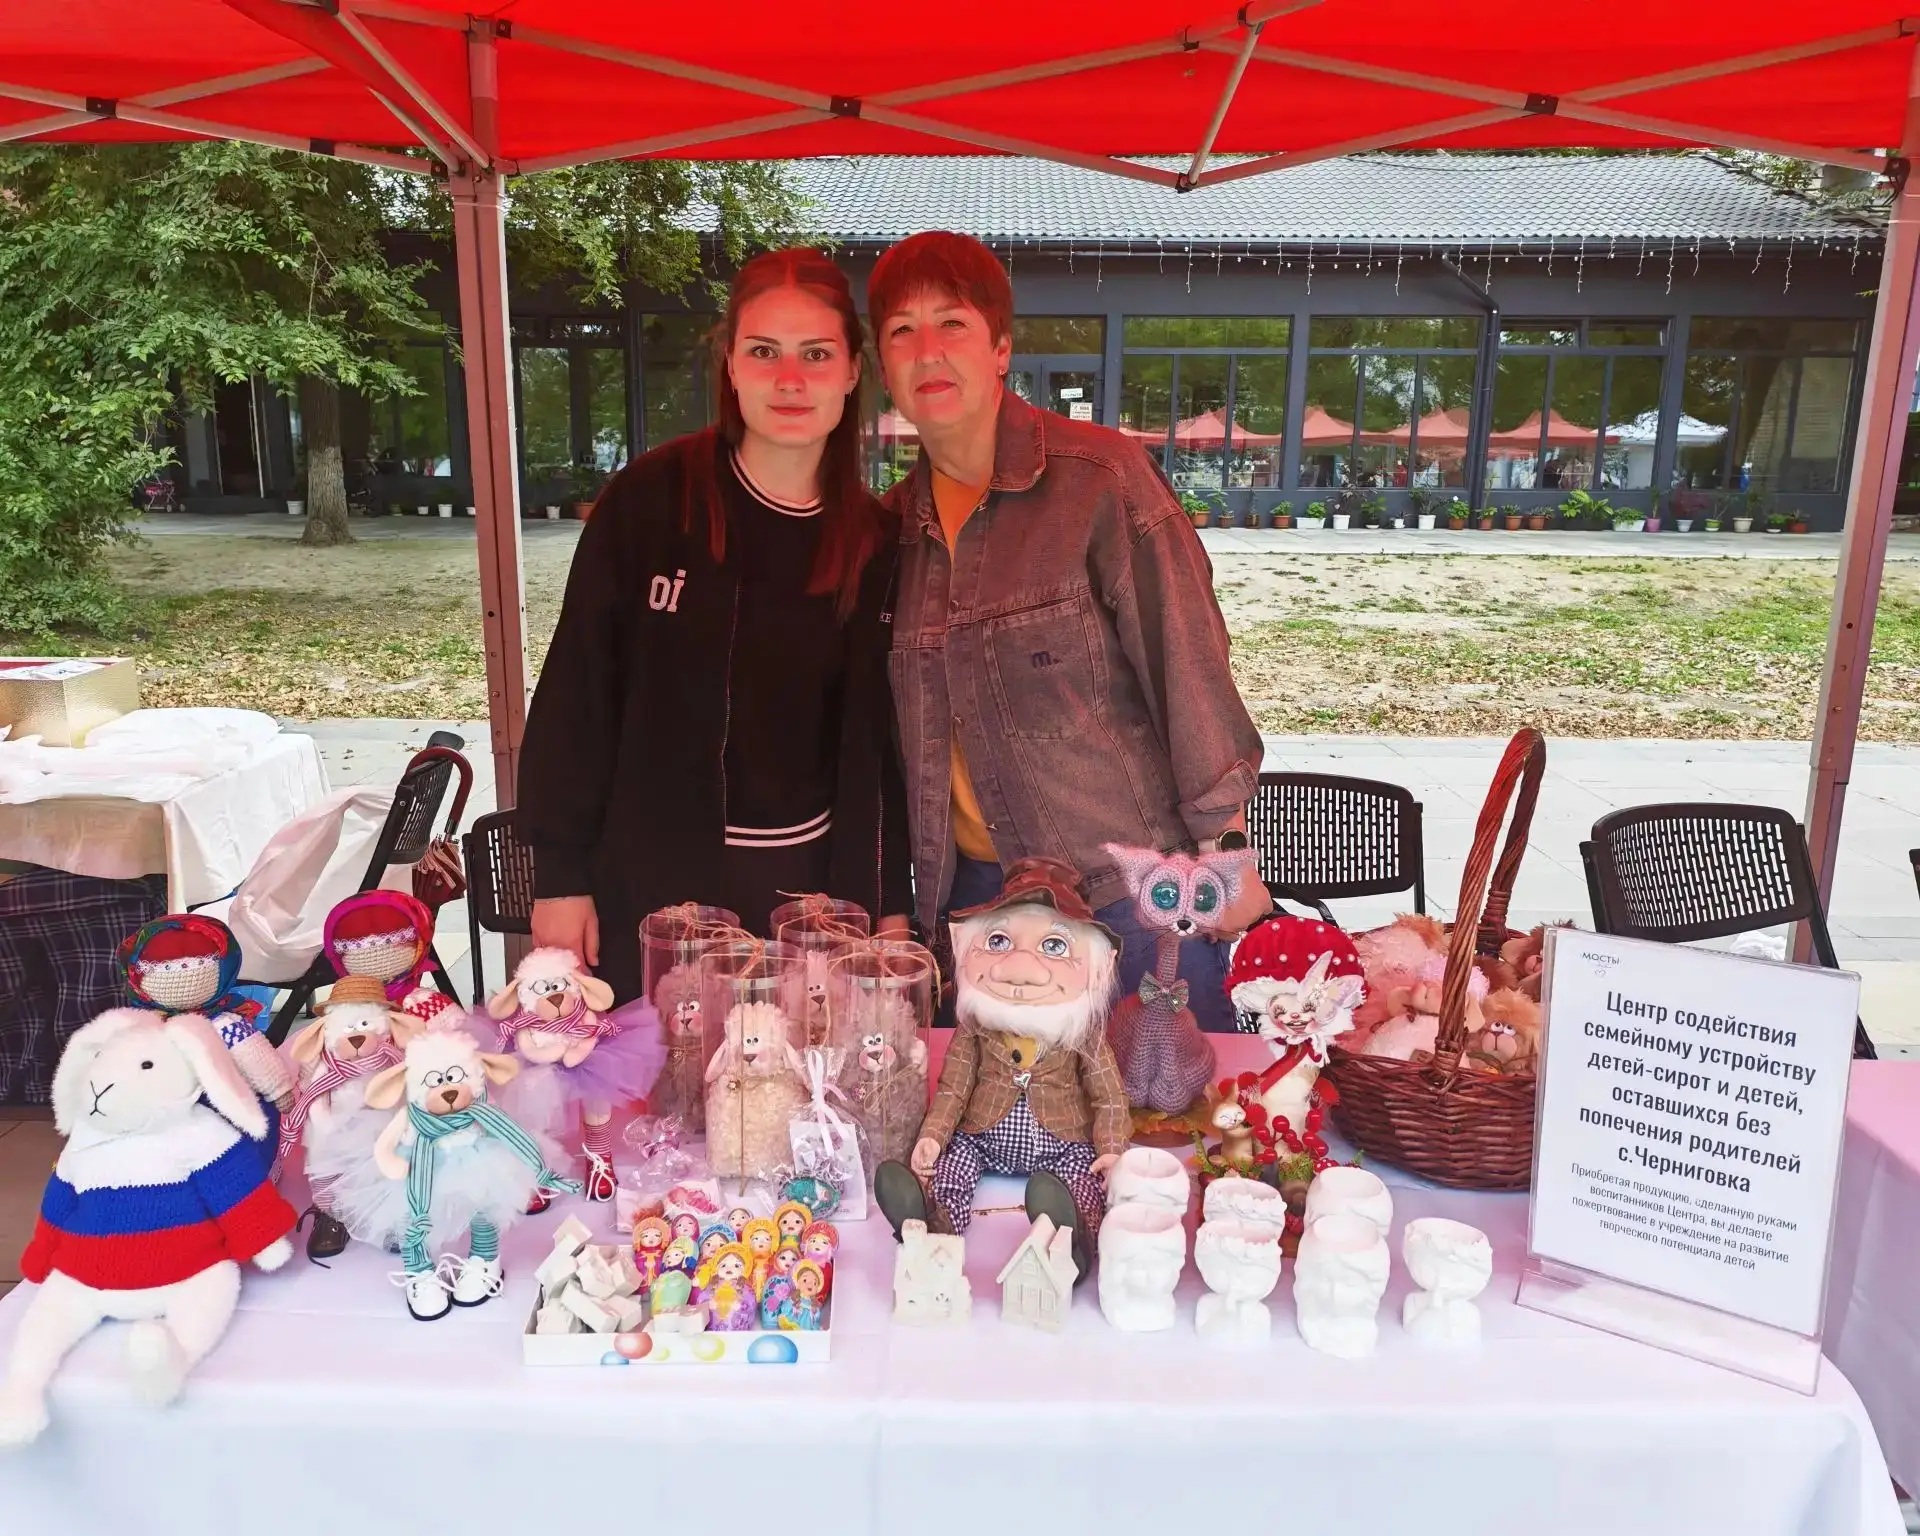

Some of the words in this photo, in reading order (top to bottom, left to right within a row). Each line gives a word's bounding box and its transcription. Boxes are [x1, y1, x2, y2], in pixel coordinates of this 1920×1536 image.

[1606, 991, 1668, 1024] Центр
[1674, 1010, 1797, 1047] содействия
[1584, 1021, 1693, 1059] семейному
[1699, 1045, 1817, 1085] устройству
[1588, 1052, 1711, 1091] детей-сирот
[1717, 1081, 1729, 1096] и
[1735, 1085, 1803, 1115] детей,
[1612, 1086, 1728, 1126] оставшихся
[1736, 1111, 1771, 1136] без
[1579, 1107, 1682, 1145] попечения
[1689, 1134, 1801, 1174] родителей
[1618, 1145, 1751, 1192] с.Черниговка
[1571, 1162, 1630, 1188] Приобретая
[1633, 1181, 1692, 1205] продукцию,
[1695, 1199, 1754, 1221] сделанную
[1757, 1214, 1797, 1232] руками
[1590, 1184, 1664, 1213] воспитанников
[1667, 1204, 1707, 1226] Центра,
[1710, 1217, 1726, 1229] вы
[1728, 1222, 1773, 1242] делаете
[1572, 1196, 1647, 1225] пожертвование
[1649, 1217, 1656, 1227] в
[1658, 1219, 1721, 1245] учреждение
[1723, 1239, 1737, 1249] на
[1739, 1241, 1790, 1263] развитие
[1599, 1219, 1658, 1244] творческого
[1661, 1236, 1722, 1261] потенциала
[1723, 1253, 1756, 1271] детей
